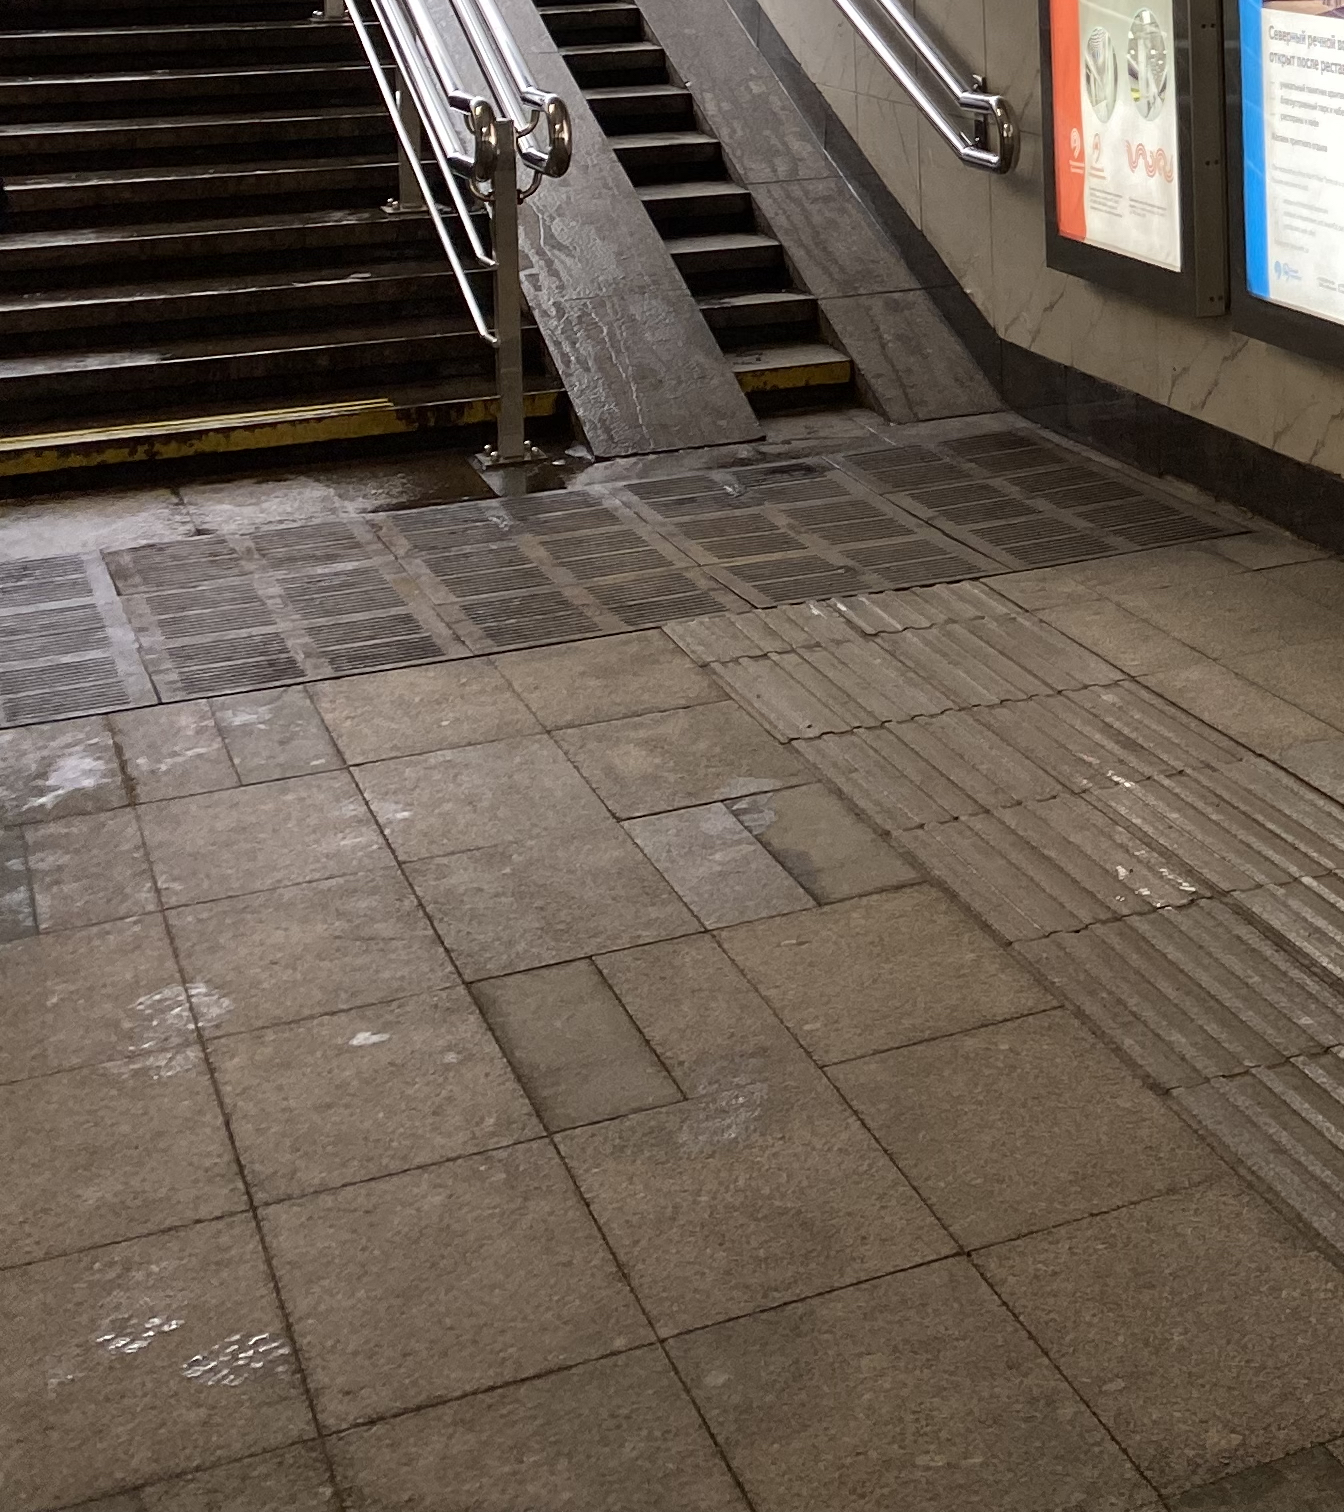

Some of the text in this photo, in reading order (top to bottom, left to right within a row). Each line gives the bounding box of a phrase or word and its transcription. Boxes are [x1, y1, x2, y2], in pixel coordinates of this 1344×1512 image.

[1268, 25, 1306, 46] Северный
[1307, 34, 1336, 49] речной
[1269, 51, 1296, 67] открыт
[1296, 56, 1320, 71] после
